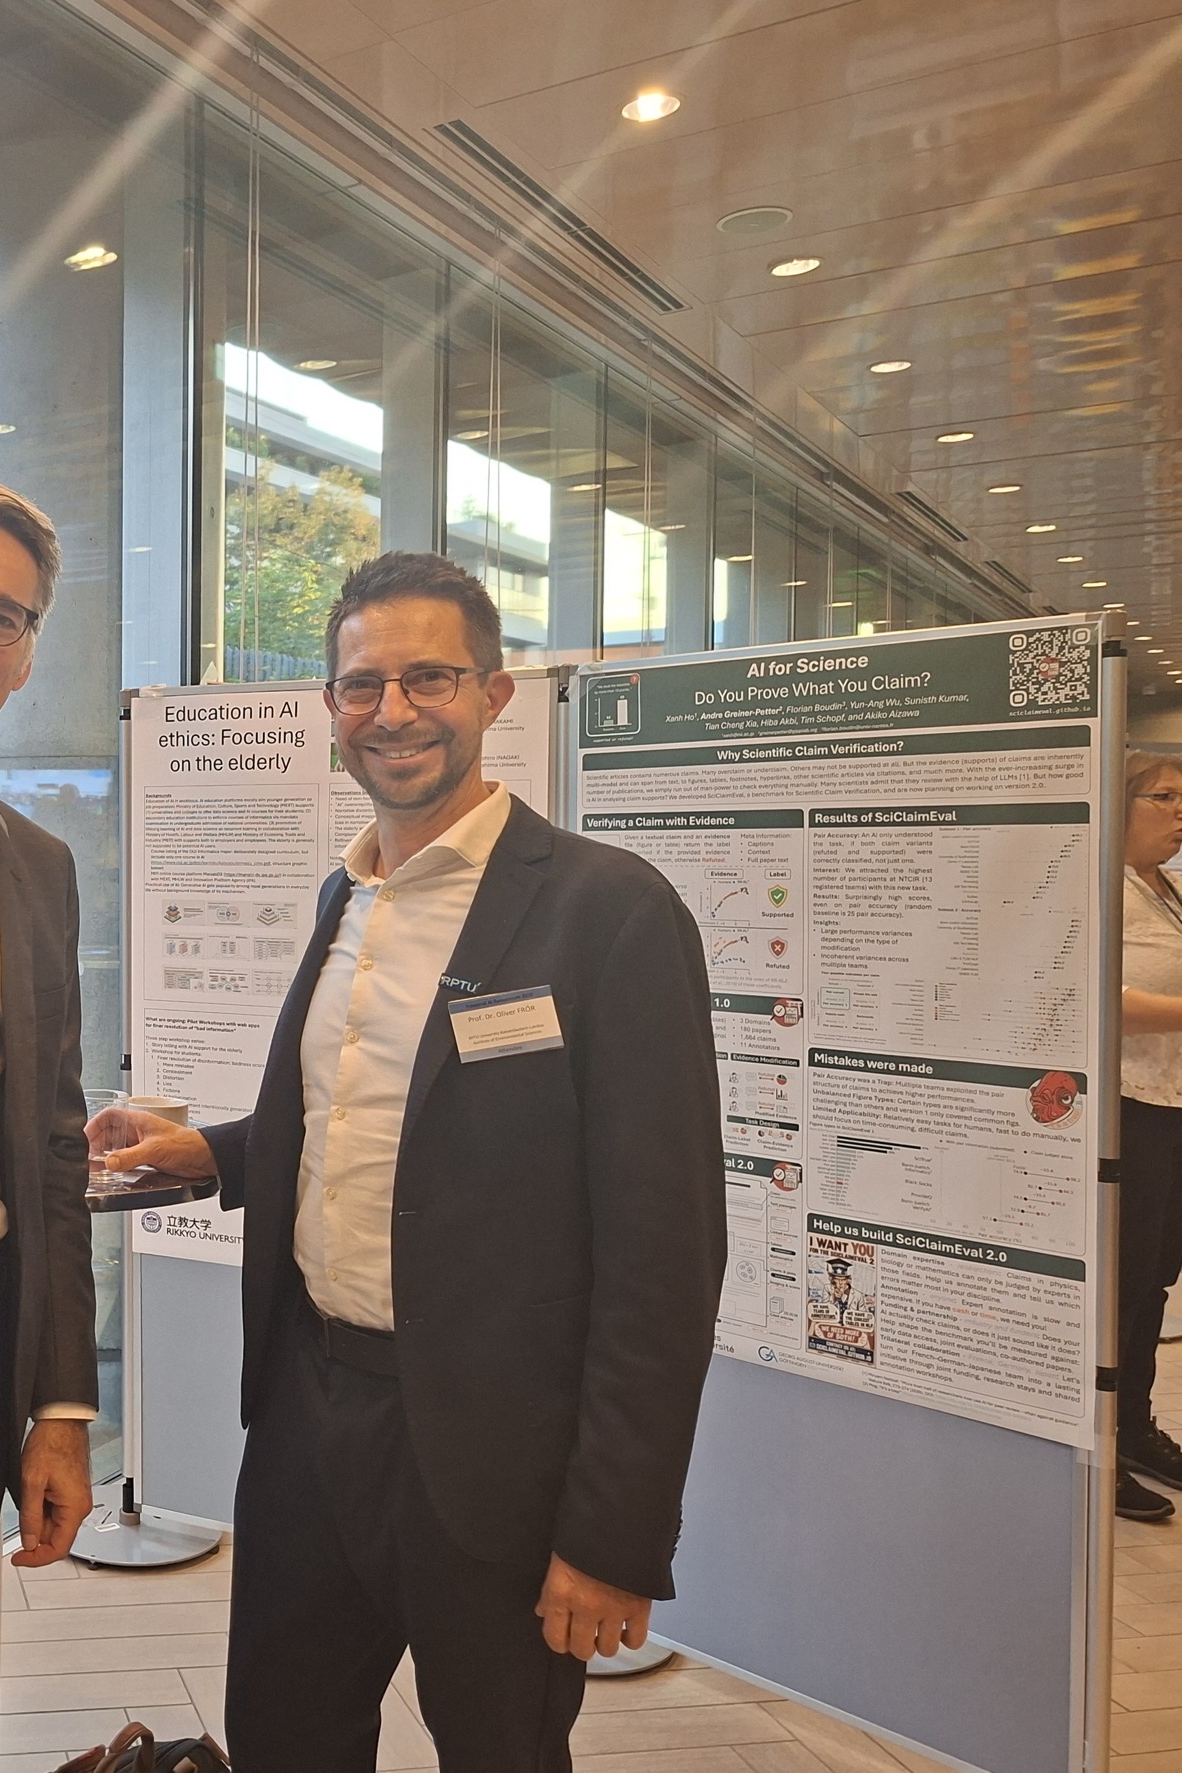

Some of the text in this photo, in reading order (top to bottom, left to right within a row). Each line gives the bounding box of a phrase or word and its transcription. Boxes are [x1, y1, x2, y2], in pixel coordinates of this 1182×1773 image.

[747, 655, 868, 678] AI for Science
[695, 672, 930, 705] Do You Prove What You Claim?
[166, 701, 298, 722] Education in AI
[665, 714, 683, 722] Xanh
[700, 712, 723, 720] Andre
[786, 705, 813, 713] Florian
[850, 699, 884, 710] Yun-Ang
[886, 698, 903, 707] Wu,
[905, 696, 937, 706] Sunisth
[939, 694, 969, 703] Kumar,
[1009, 706, 1091, 717] sciclaimeval.github.io
[705, 722, 719, 730] Tian
[721, 721, 744, 729] Cheng
[745, 720, 758, 728] Xia,
[779, 717, 799, 726] Akbi,
[801, 715, 814, 724] Tim
[816, 713, 846, 724] Schopf,
[848, 712, 863, 721] and
[865, 711, 887, 720] Akiko
[889, 709, 920, 718] Aizawa
[159, 727, 305, 747] ethics: Focusing
[717, 740, 904, 762] Why Scientific Claim Verification?
[961, 756, 998, 765] (supports)
[1047, 753, 1084, 762] inherently
[170, 753, 291, 773] on the elderly
[587, 817, 626, 829] Verifying
[636, 817, 664, 826] Claim
[666, 816, 687, 826] with
[690, 816, 735, 826] Evidence
[814, 811, 957, 824] Results of SciClaimEval
[762, 911, 794, 919] Supported
[714, 998, 730, 1008] 1.0
[496, 1010, 516, 1018] Oliver
[748, 1043, 780, 1051] Annotators
[733, 1054, 797, 1066] Evidence Modification
[814, 1053, 933, 1075] Mistakes were made
[759, 1120, 780, 1128] Design
[737, 1160, 754, 1170] 2.0
[167, 1215, 212, 1231] 立教大学
[167, 1228, 196, 1238] RIKKYO
[813, 1218, 1007, 1263] Help us build SciClaimEval 2.0
[810, 1236, 874, 1257] I WANT YOU
[881, 1283, 918, 1296] Annotation
[1006, 1271, 1081, 1292] Claims physics,
[880, 1301, 958, 1323] Funding partnership
